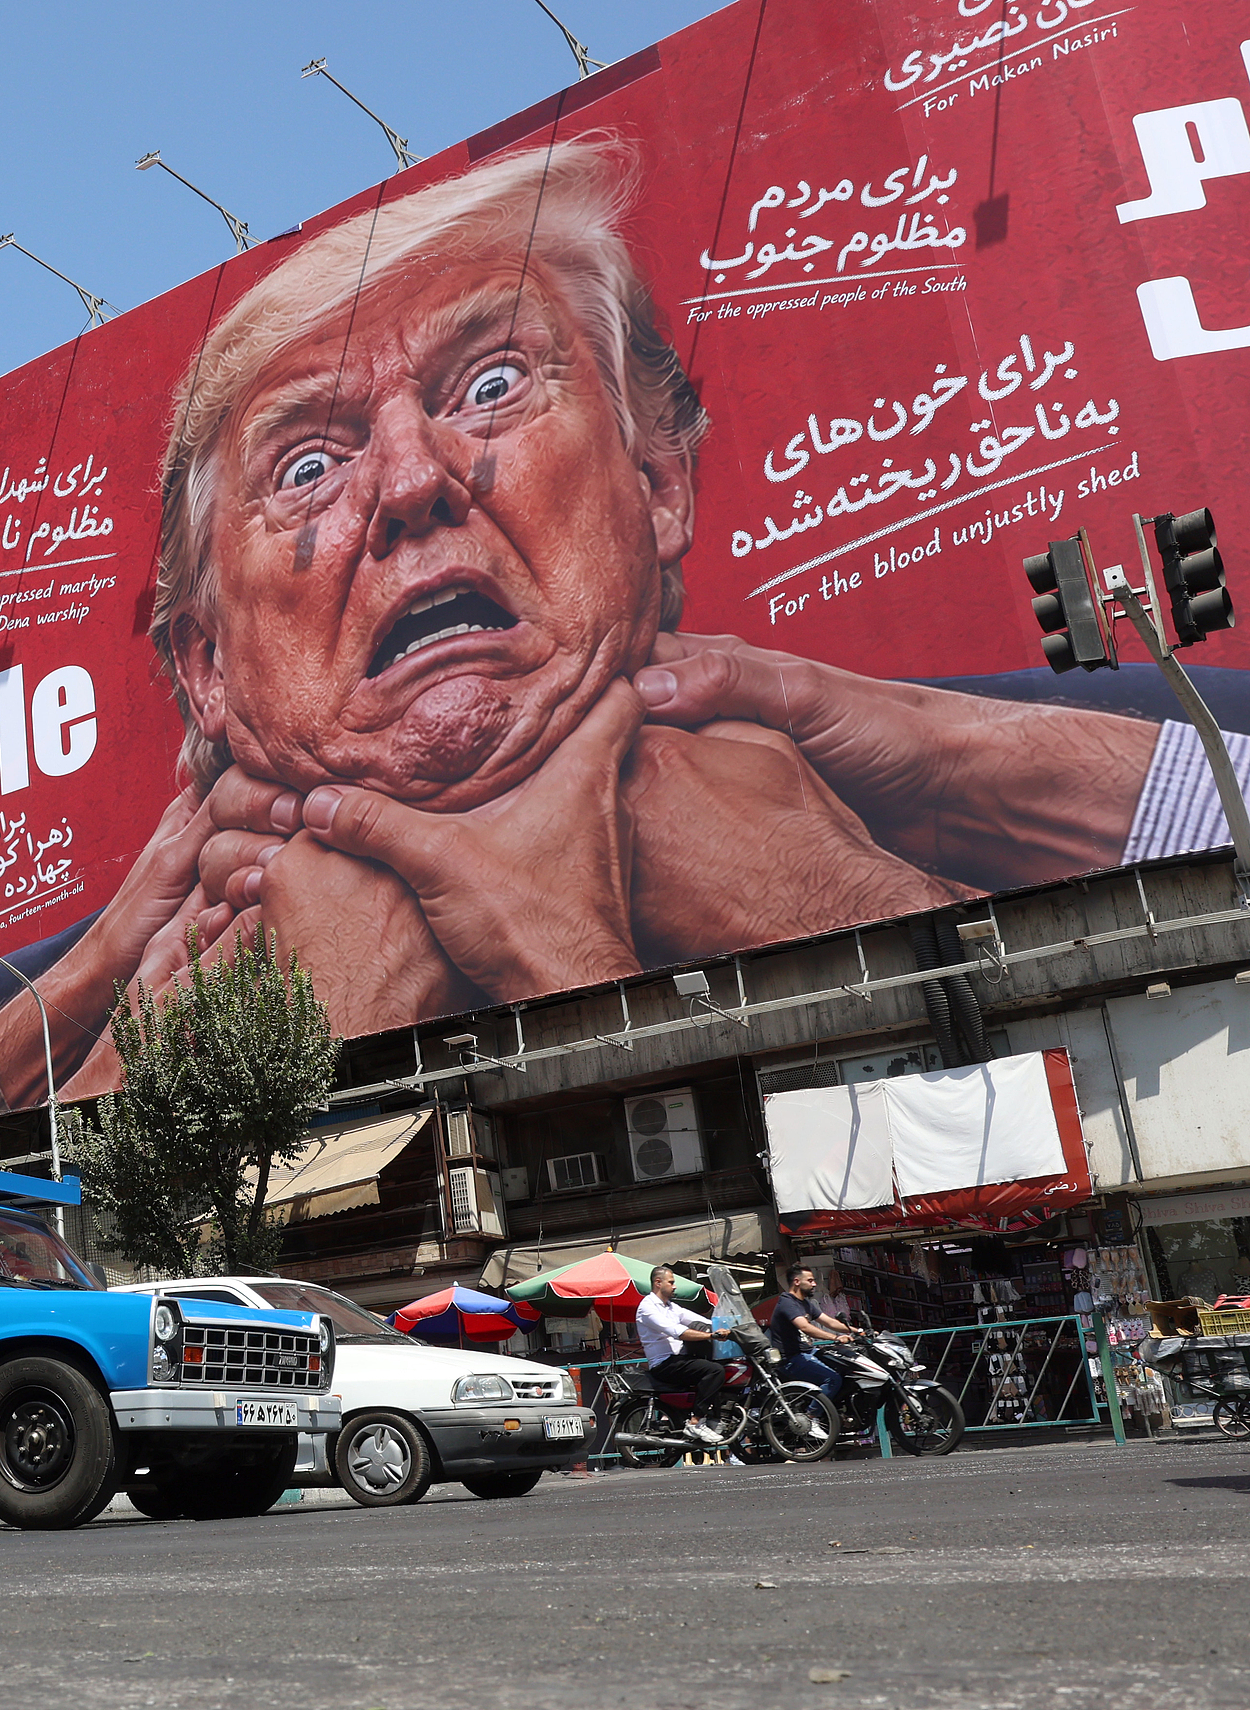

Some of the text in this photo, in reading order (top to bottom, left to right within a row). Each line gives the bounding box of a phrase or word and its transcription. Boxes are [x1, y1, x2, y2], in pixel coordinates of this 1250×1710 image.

[884, 7, 1028, 92] نصیری
[922, 22, 1119, 118] For Makan Nasiri
[748, 154, 959, 232] برای مردم
[699, 212, 967, 284] مظلوم جنوب
[687, 275, 968, 325] For the oppressed people of the South
[977, 334, 1079, 402] برای
[53, 454, 108, 498] برای
[25, 504, 114, 562] مظلوم
[768, 451, 1141, 625] For the blood unjustly shed
[59, 574, 117, 600] martyrs
[36, 602, 90, 628] warship
[26, 817, 74, 863] زهرا
[4, 858, 73, 900] چهارده
[9, 881, 85, 925] fourteen-month-old
[1044, 1181, 1078, 1195] رضی
[1184, 1202, 1225, 1215] Shiva
[243, 1403, 255, 1423] ۶۶
[286, 1409, 296, 1424] ۵۰
